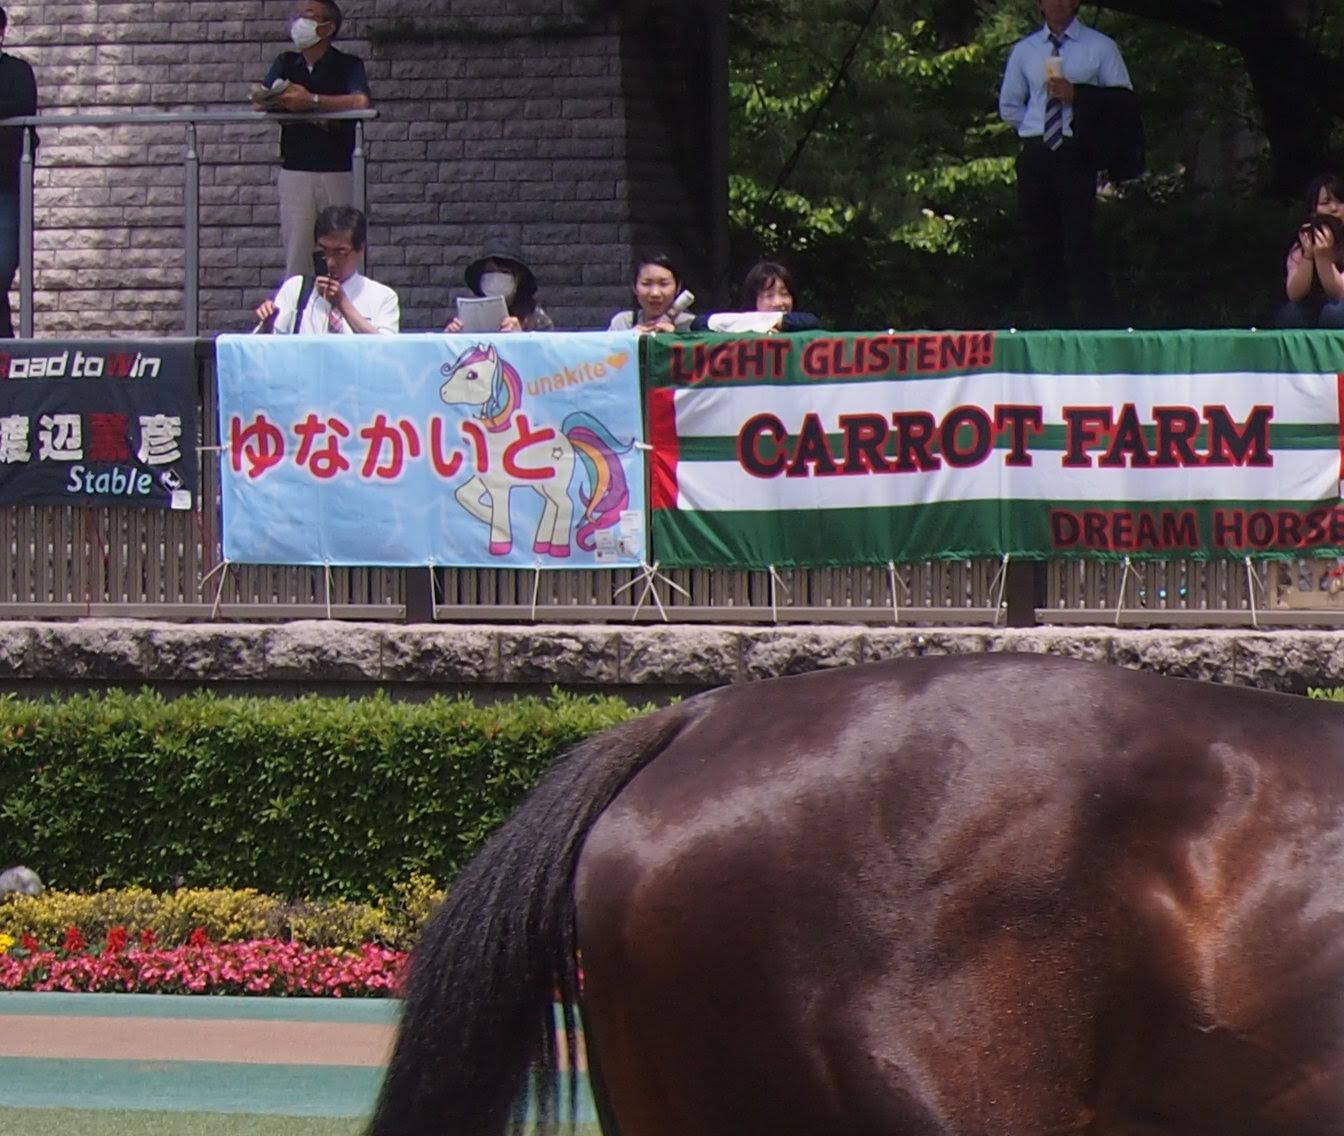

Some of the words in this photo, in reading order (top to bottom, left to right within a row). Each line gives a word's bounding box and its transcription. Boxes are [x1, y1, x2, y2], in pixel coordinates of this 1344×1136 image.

[71, 350, 105, 378] to
[107, 351, 162, 379] Win
[527, 361, 608, 396] unakite
[671, 338, 793, 384] LIGHT
[801, 331, 996, 379] GLISTEN!!
[229, 411, 559, 482] ゆなかいと
[737, 404, 1045, 479] CARROT
[1062, 403, 1276, 469] FARM
[66, 464, 153, 495] Stable
[1050, 509, 1199, 551] DREAM
